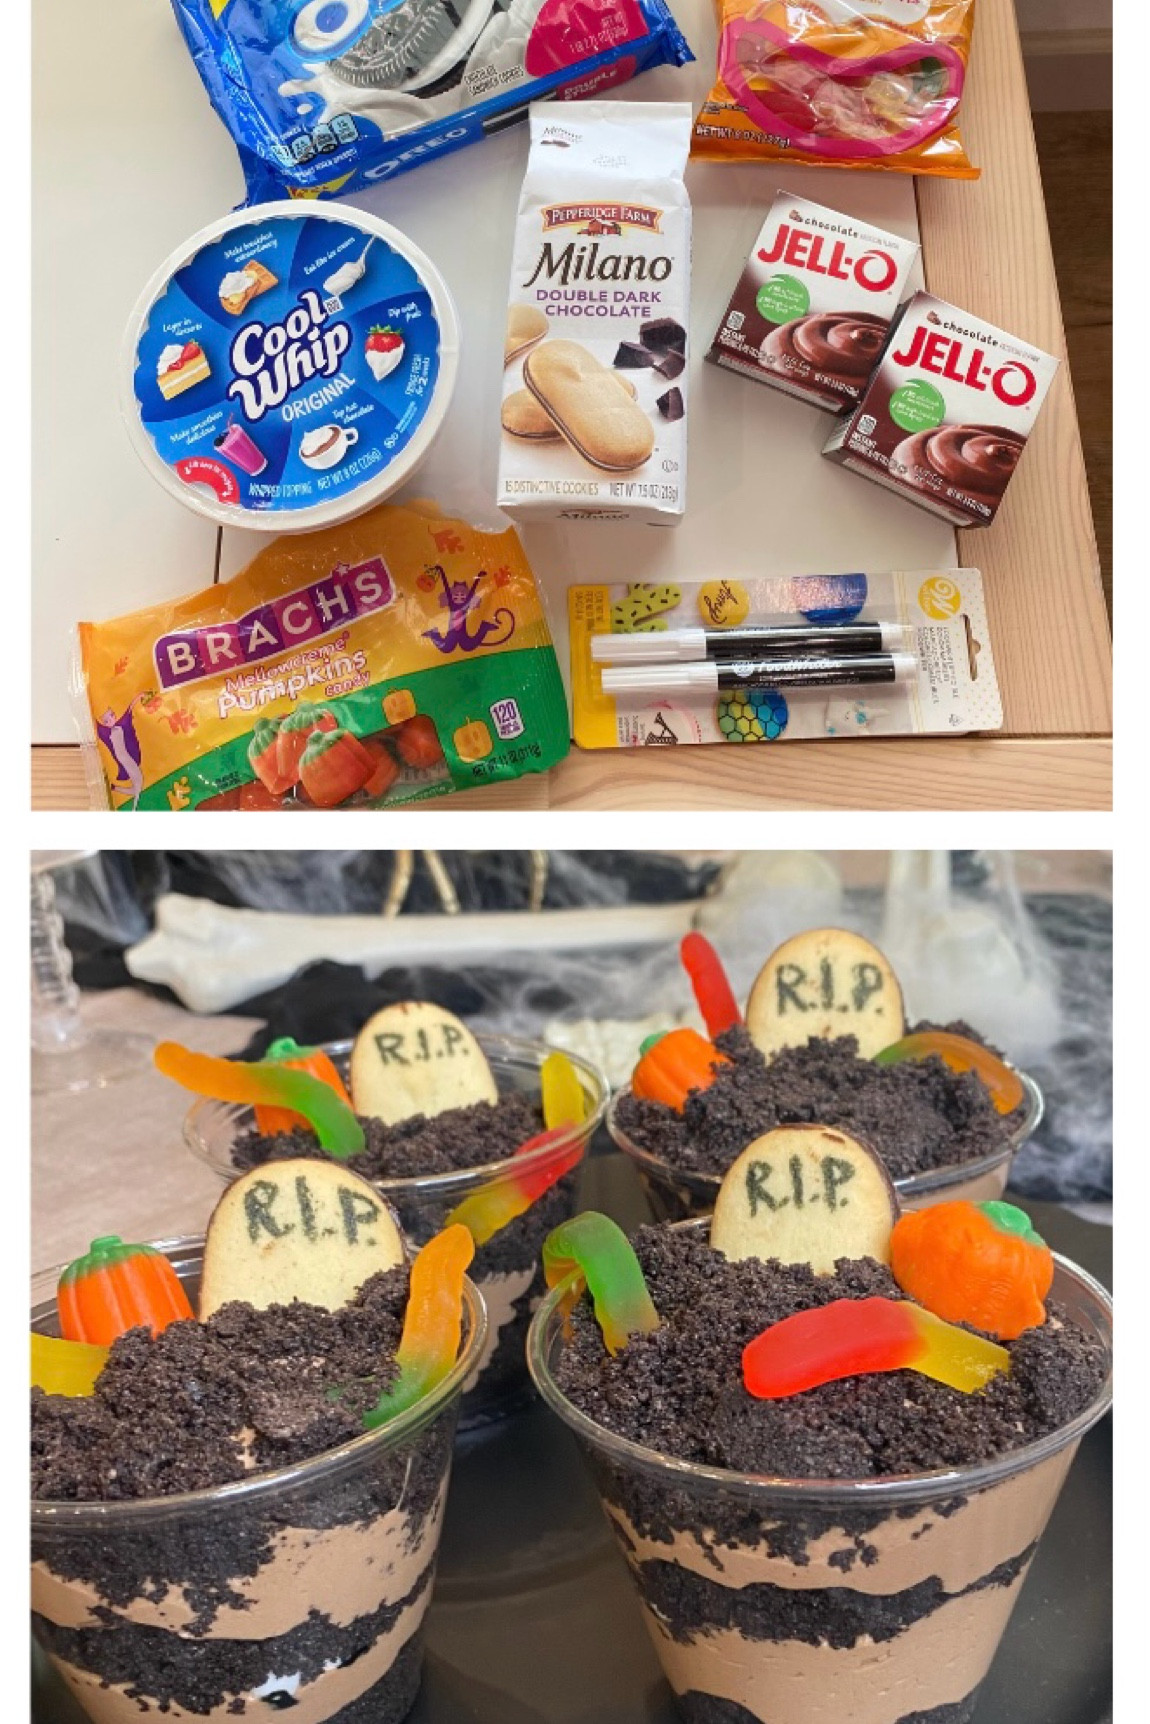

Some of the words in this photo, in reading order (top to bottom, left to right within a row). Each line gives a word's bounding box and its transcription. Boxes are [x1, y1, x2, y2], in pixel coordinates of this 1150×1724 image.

[551, 206, 617, 224] PEPPERIDGE
[620, 206, 651, 223] FARM
[804, 216, 859, 239] chocolate
[522, 242, 673, 288] Milano
[757, 223, 898, 293] JELL-O
[536, 289, 608, 303] DOUBLE
[613, 290, 662, 303] DARK
[545, 304, 652, 318] CHOCOLATE
[232, 291, 327, 376] Cool
[943, 321, 999, 348] chocolate
[228, 323, 349, 420] Whip
[891, 326, 1037, 407] JELL-O
[281, 372, 356, 422] ORIGINAL
[562, 481, 599, 497] COOKIES
[225, 637, 347, 692] Mellowcreme
[217, 650, 368, 719] Pumpkins
[324, 670, 371, 697] candy
[493, 701, 517, 724] 120
